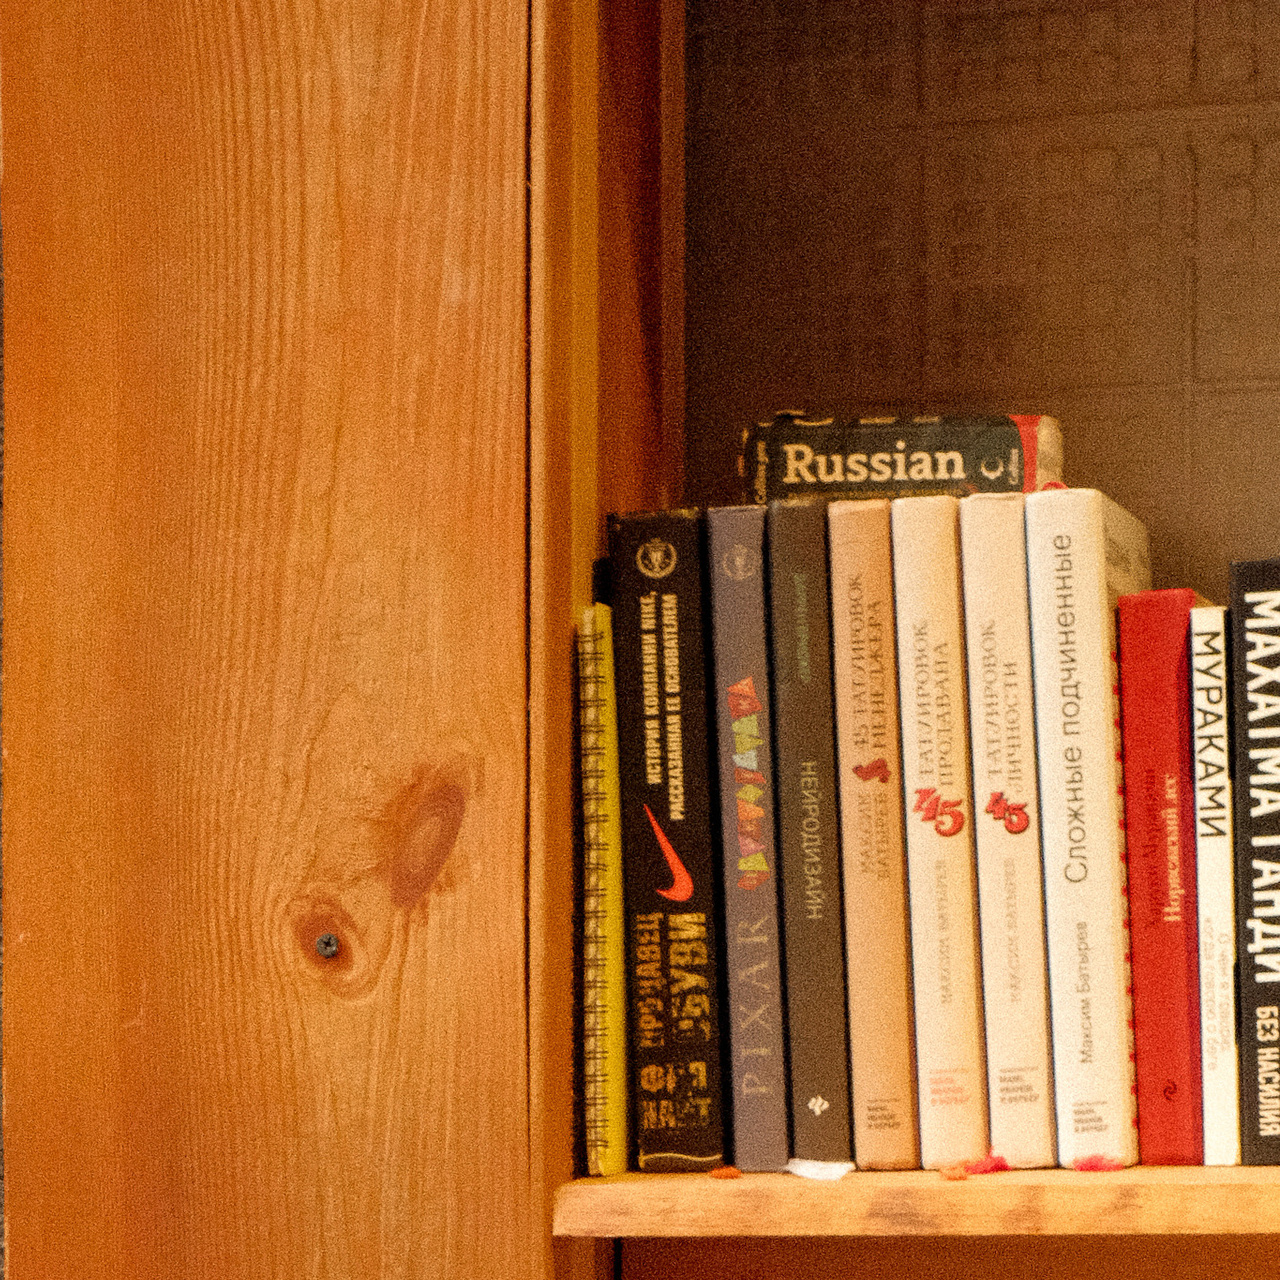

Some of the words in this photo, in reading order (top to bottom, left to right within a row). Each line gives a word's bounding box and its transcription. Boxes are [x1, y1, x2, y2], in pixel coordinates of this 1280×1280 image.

[782, 440, 966, 484] Russian
[639, 591, 658, 630] NIKE,
[661, 593, 681, 693] ОСНОВАТЕЛЕМ
[848, 573, 869, 717] ТАТУИРОВОК
[1052, 534, 1083, 737] подчиненные
[641, 634, 660, 716] КОМПАНИИ
[867, 598, 887, 750] МЕНЕДЖЕРА
[913, 622, 935, 777] ТАТУИРОВОК
[933, 641, 955, 788] ПРОДАВАНА
[982, 620, 1003, 779] ТАТУИРОВОК
[645, 719, 663, 785] ИСТОРИЯ
[665, 714, 685, 821] РАССКАЗАННАЯ
[851, 723, 869, 751] 45
[1003, 661, 1023, 794] ЛИЧНОСТИ
[1194, 630, 1227, 838] МУРАКАМИ
[801, 760, 823, 920] НЕЙРОДИЗАЙН
[874, 792, 890, 880] БАТЫРЕВ
[913, 787, 966, 837] 45
[985, 791, 1031, 835] 45
[1062, 746, 1090, 884] Сложные
[1161, 808, 1185, 922] Норвежский
[738, 915, 771, 1097] PIXAR
[1075, 921, 1093, 993] Батырев
[1078, 998, 1094, 1064] Максим
[1256, 1005, 1279, 1041] БЕЗ
[1257, 1047, 1280, 1136] НАСИЛИЯ
